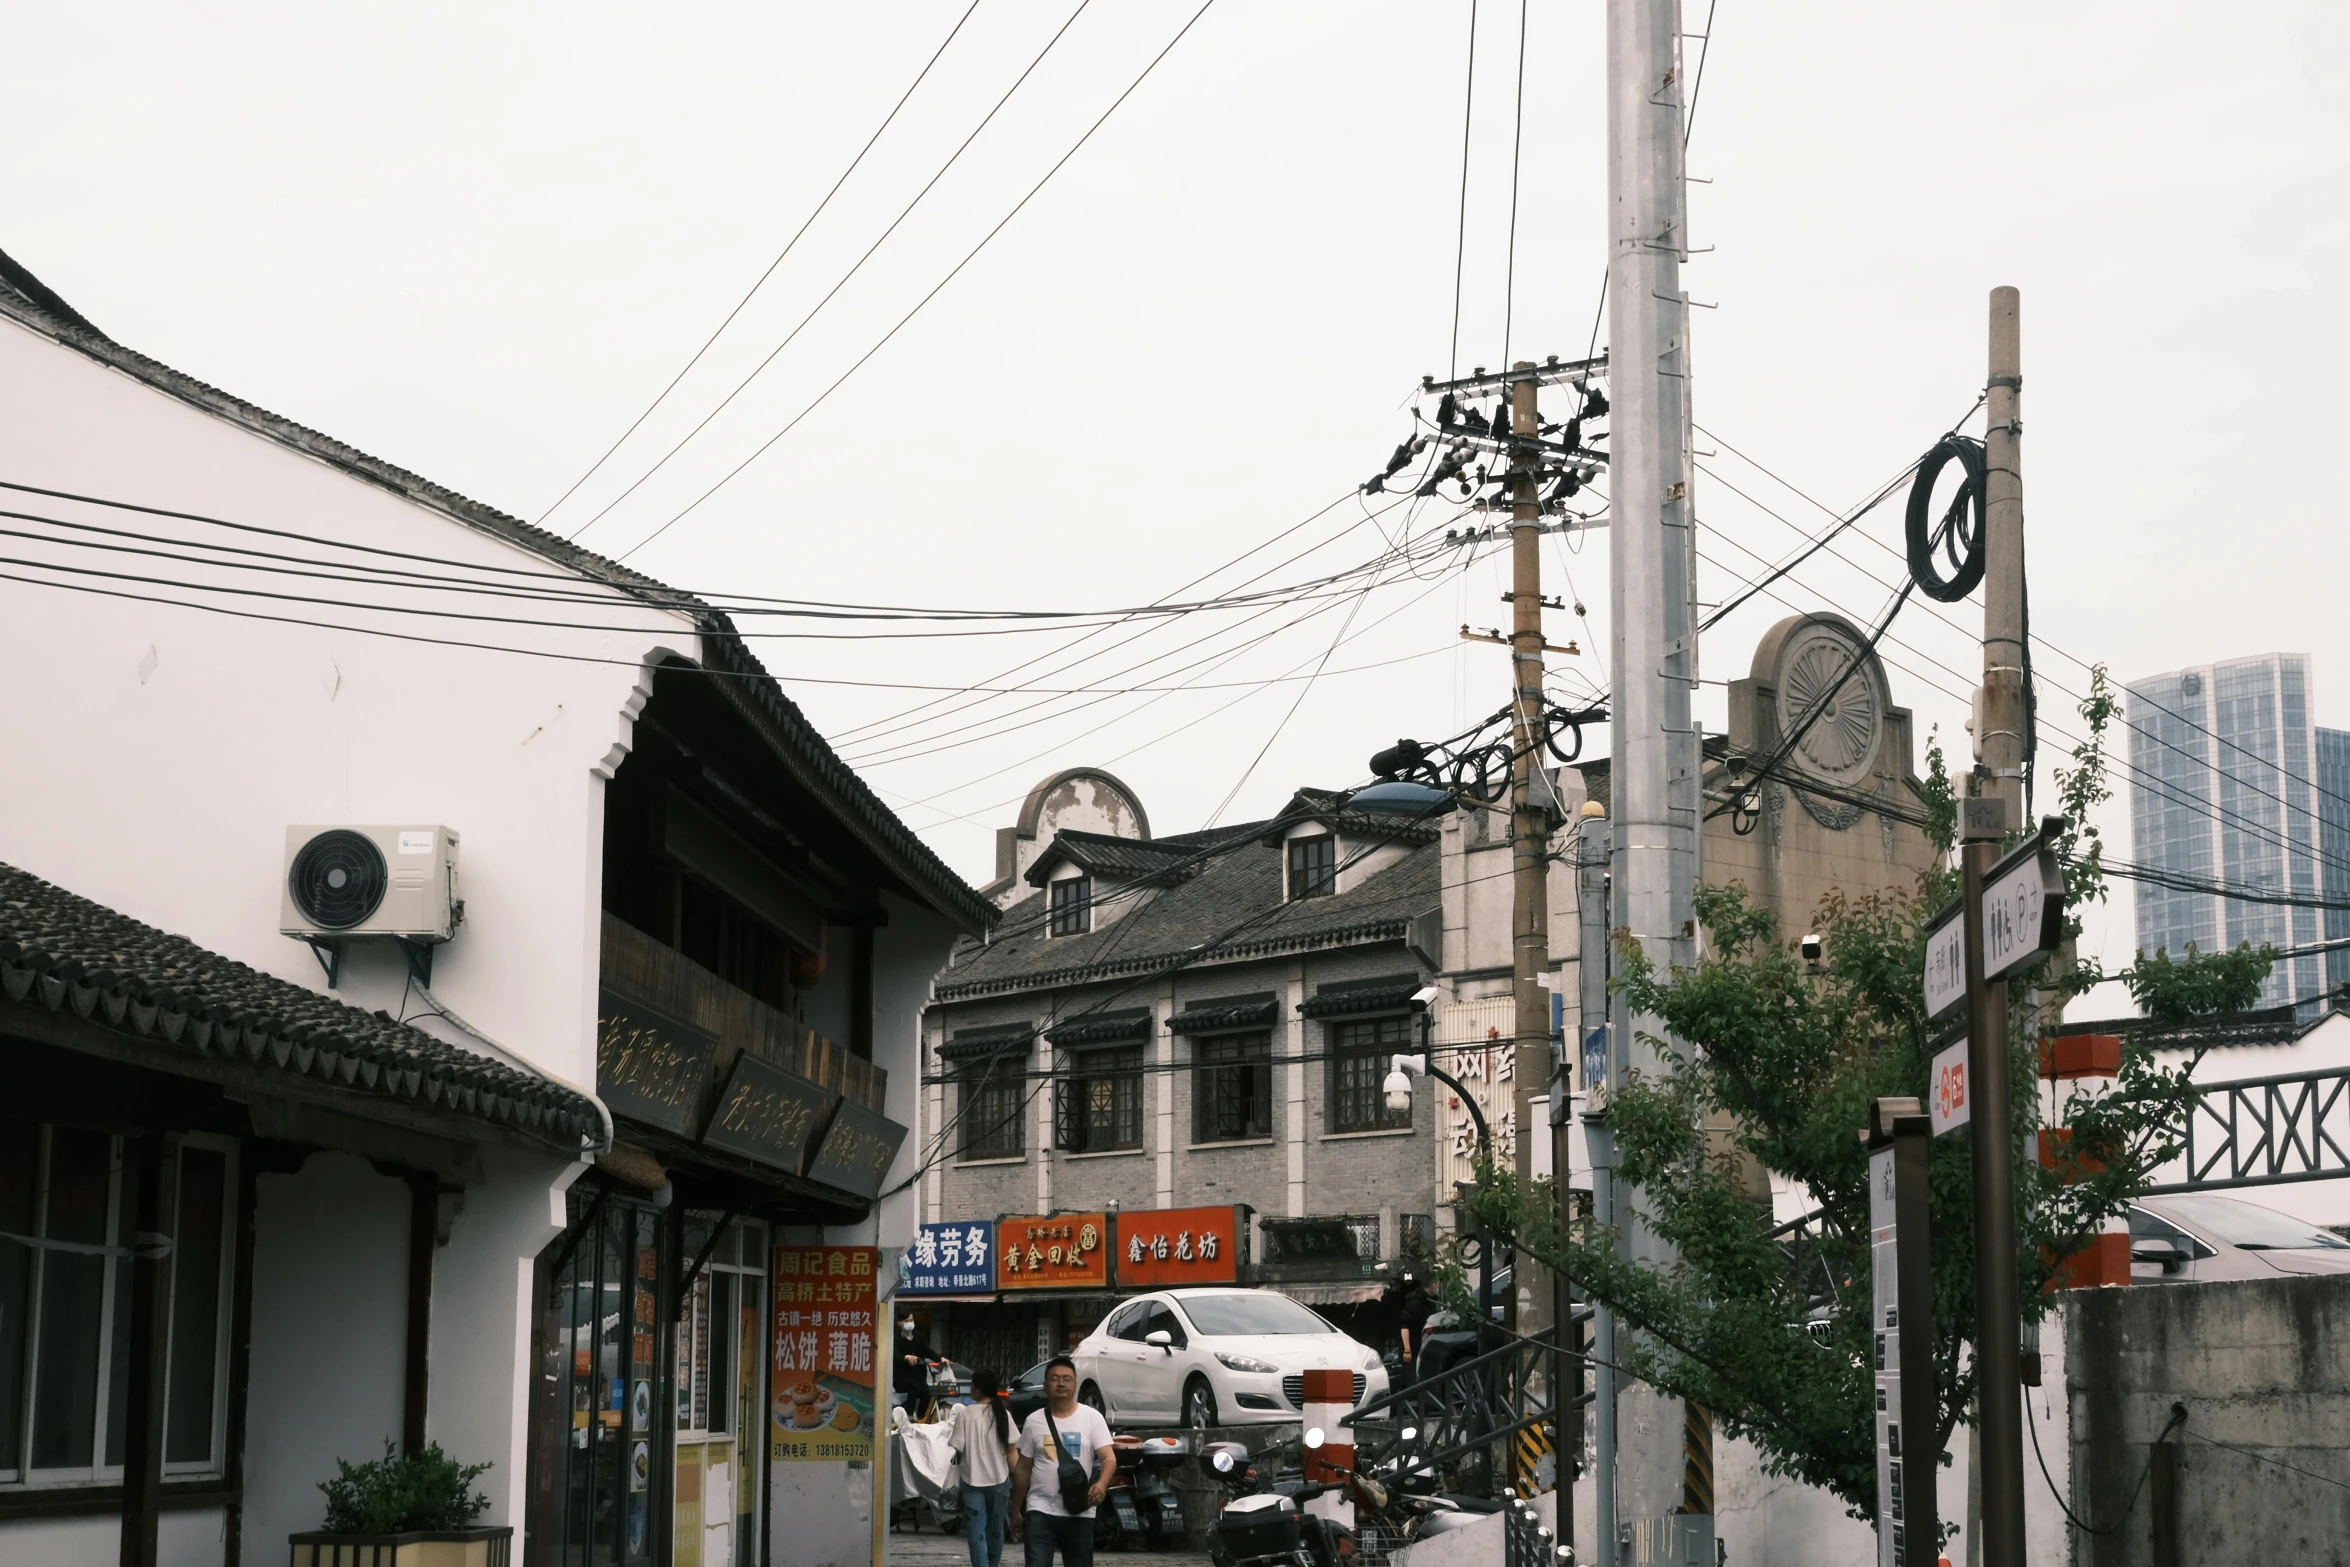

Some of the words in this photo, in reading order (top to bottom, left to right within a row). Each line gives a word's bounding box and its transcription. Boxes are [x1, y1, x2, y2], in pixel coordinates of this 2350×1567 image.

[1003, 1243, 1084, 1272] 黄金回收
[1127, 1230, 1217, 1263] 鑫怡花坊
[780, 1251, 871, 1276] 周记食品
[778, 1281, 872, 1304] 高桥土特产
[778, 1310, 823, 1327] 古镇一绝
[827, 1310, 872, 1328] 历史悠久
[775, 1330, 818, 1372] 松饼
[828, 1330, 871, 1372] 薄脆
